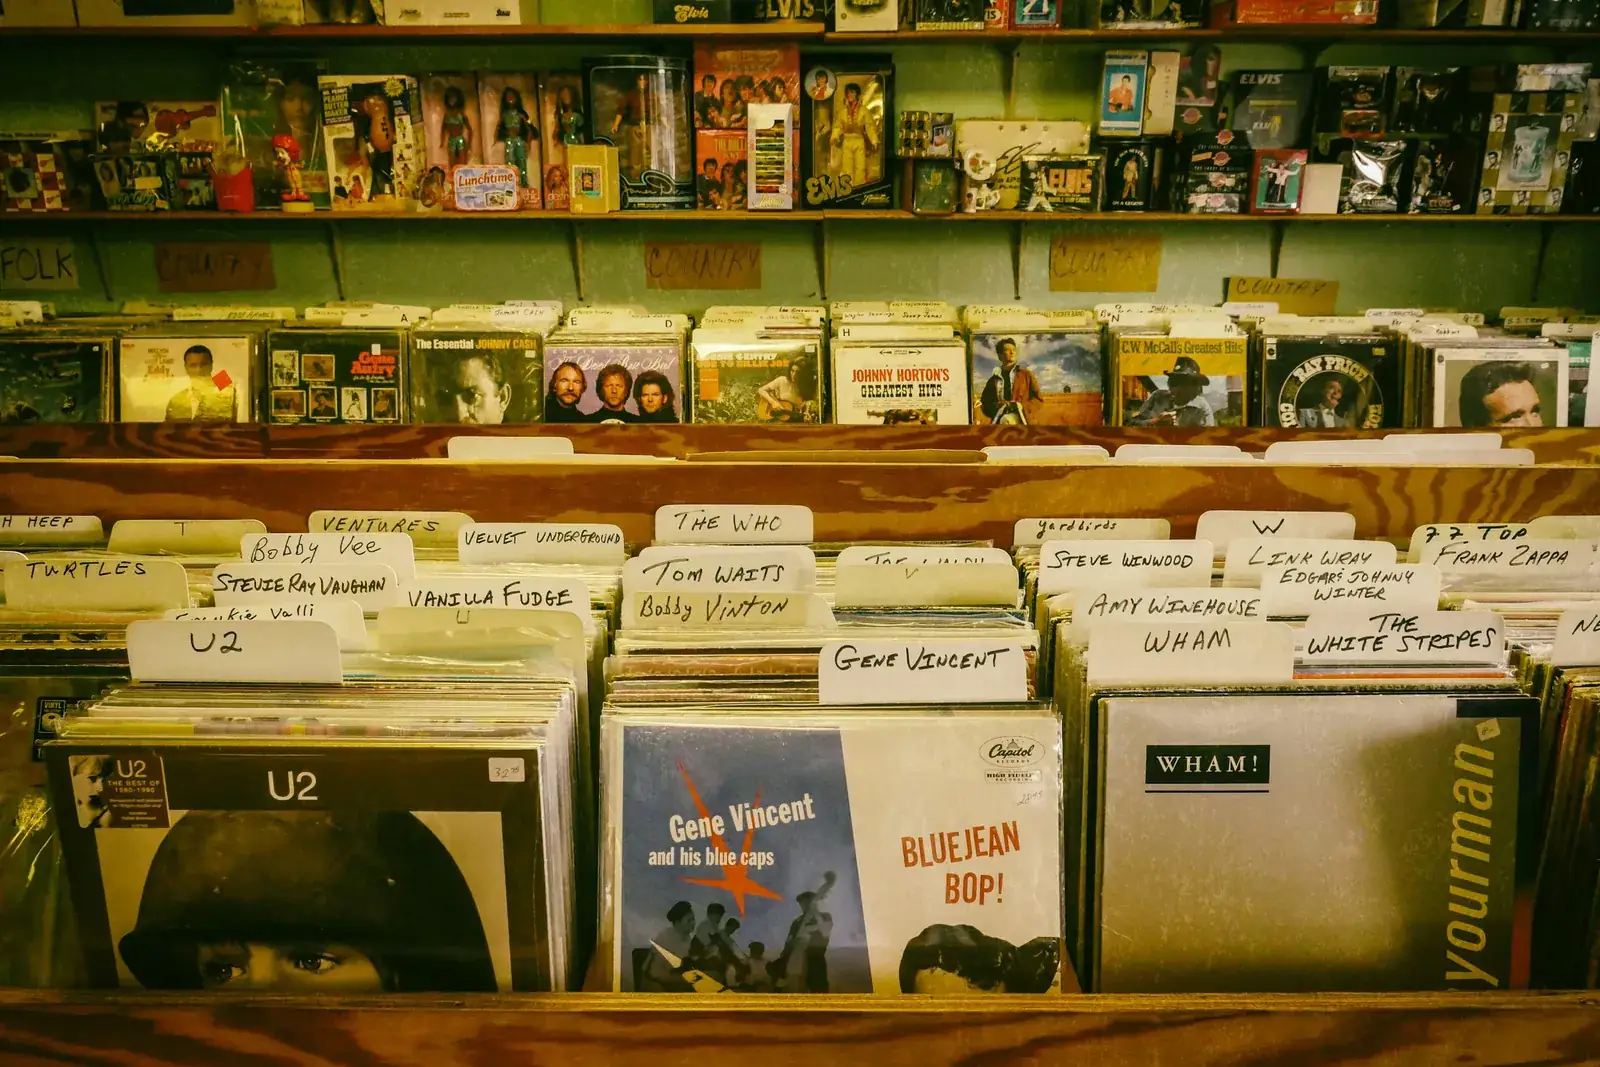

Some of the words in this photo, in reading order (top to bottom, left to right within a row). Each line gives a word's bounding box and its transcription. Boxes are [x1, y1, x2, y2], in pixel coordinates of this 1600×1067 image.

[674, 4, 710, 23] Elvis
[1240, 73, 1284, 85] ELVIS
[458, 172, 514, 187] Lunchtime
[1, 247, 73, 282] FOLK
[649, 246, 760, 279] COUNTRY
[1236, 278, 1327, 297] COUNTRY
[400, 313, 408, 322] A
[570, 317, 578, 326] E
[665, 319, 673, 328] D
[1111, 313, 1120, 323] N
[1258, 317, 1266, 326] P
[842, 328, 851, 337] H
[1224, 324, 1234, 333] M
[416, 338, 431, 350] The
[433, 338, 474, 350] Essential
[475, 338, 511, 350] JOHNNY
[513, 338, 537, 350] CASH
[1184, 340, 1223, 355] Greatest
[1224, 341, 1243, 354] Hits
[852, 369, 894, 383] JOHNNY
[896, 368, 950, 382] HORTON'S
[1293, 357, 1323, 383] RAY
[1323, 356, 1369, 383] PRICE
[861, 384, 914, 398] GREATEST
[918, 383, 943, 397] HITS
[28, 516, 74, 529] HEEP
[173, 521, 187, 537] T
[323, 516, 441, 534] VENTURES
[674, 509, 719, 531] THE
[733, 513, 783, 532] WHO
[1037, 520, 1118, 539] yardbirds
[1251, 518, 1285, 535] W
[464, 530, 527, 546] VELVET
[536, 530, 622, 546] UNDERGROUND
[1477, 525, 1528, 540] TOP
[249, 535, 320, 563] Bobby
[339, 535, 383, 556] Vee
[1248, 545, 1314, 566] LINK
[1320, 550, 1373, 565] WRAY
[1434, 541, 1502, 566] FRANK
[1509, 545, 1570, 567] ZAPPA
[1047, 550, 1113, 569] STEVE
[1122, 553, 1195, 569] WINWOOD
[26, 561, 148, 580] TURTLES
[715, 565, 786, 585] WAITS
[1347, 569, 1416, 585] JOHNNY
[213, 573, 285, 593] STEVIE
[287, 574, 317, 595] RAY
[319, 576, 386, 596] VAUGHAN
[1313, 586, 1388, 601] WINTER
[407, 588, 494, 608] VANILLA
[502, 581, 574, 608] FUDGE
[270, 603, 315, 620] Valli
[640, 594, 693, 623] Bobby
[1088, 593, 1143, 616] AMY
[1148, 597, 1261, 618] WINEHOUSE
[1369, 612, 1420, 633] THE
[190, 630, 243, 655] U2
[1144, 628, 1233, 653] WHAM
[1308, 635, 1384, 656] WHITE
[1399, 628, 1498, 653] STRIPES
[834, 644, 899, 671] GENE
[905, 646, 1011, 671] VINCENT
[988, 743, 1035, 760] Capitol
[117, 759, 148, 779] U2
[1156, 754, 1260, 774] WHAM!
[267, 771, 319, 802] U2
[668, 809, 727, 844] Gene
[728, 793, 817, 832] Vincent
[647, 847, 675, 866] and
[679, 846, 702, 866] his
[705, 846, 737, 866] blue
[740, 848, 775, 871] caps
[944, 872, 1004, 906] BOP!
